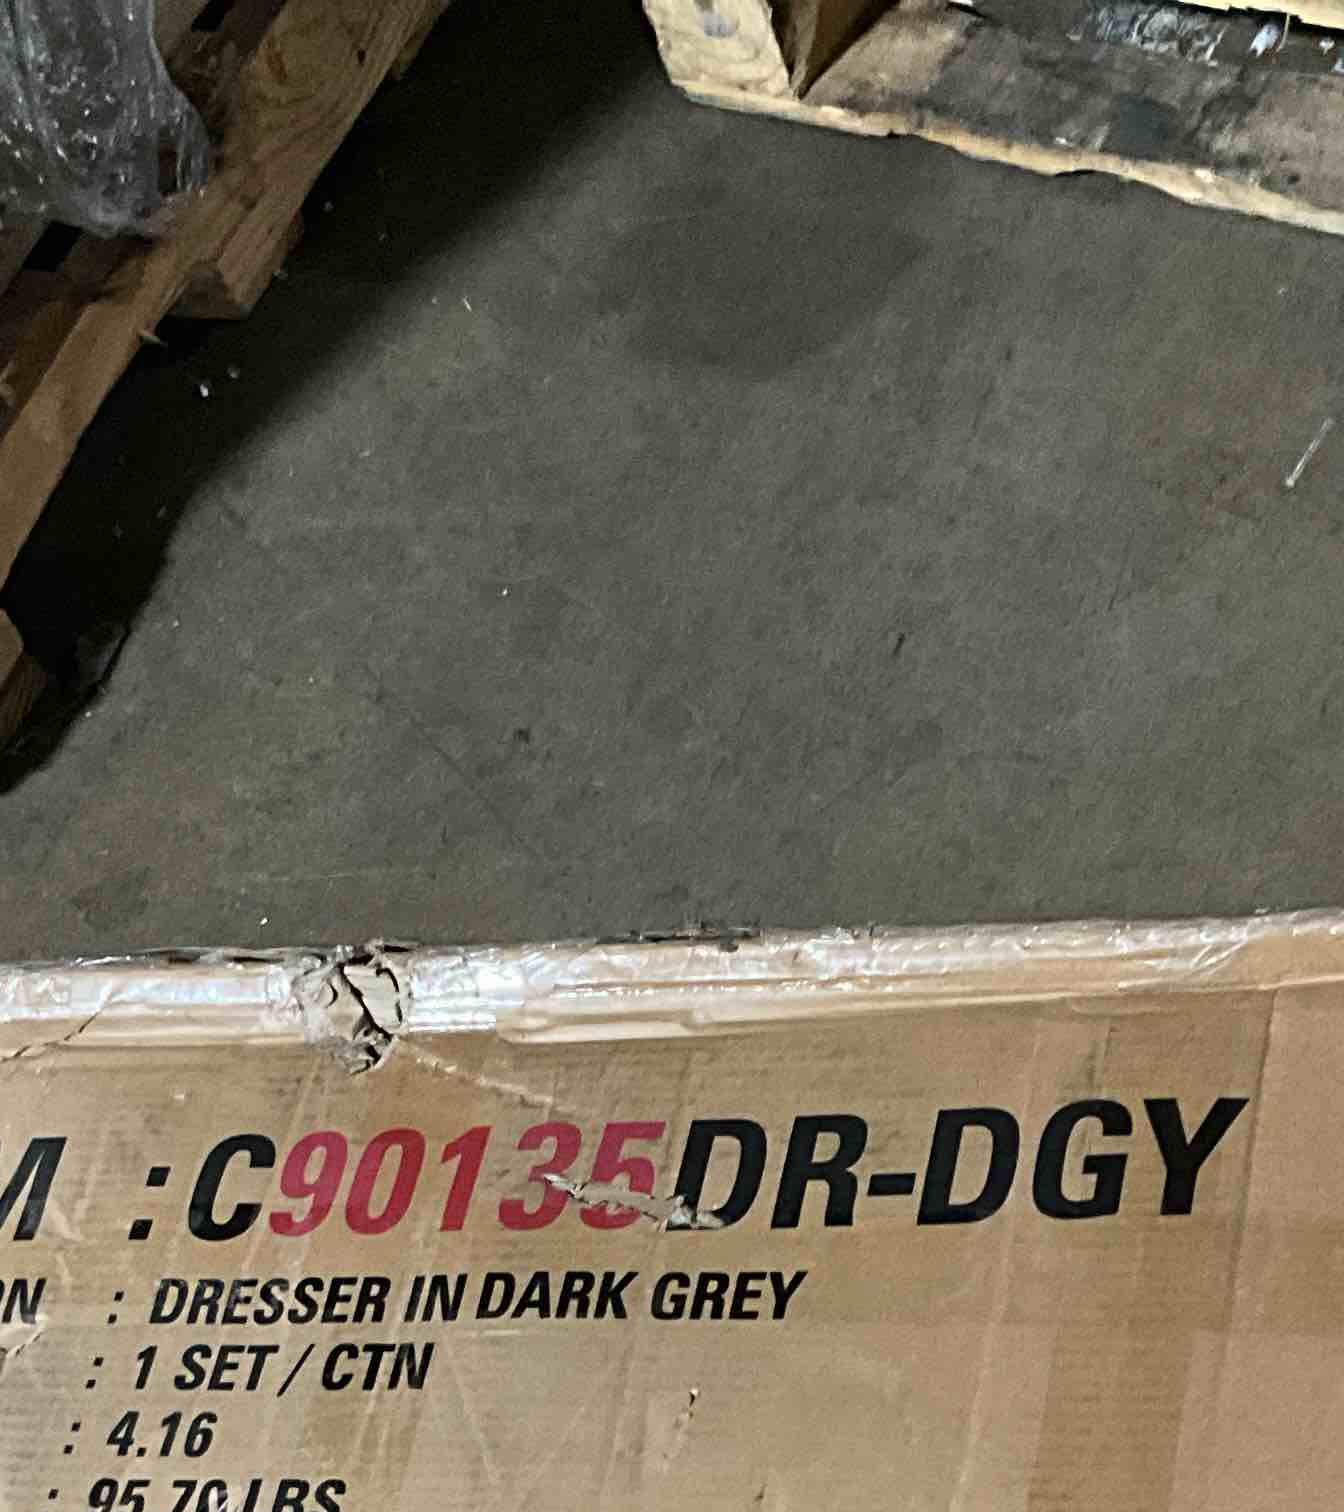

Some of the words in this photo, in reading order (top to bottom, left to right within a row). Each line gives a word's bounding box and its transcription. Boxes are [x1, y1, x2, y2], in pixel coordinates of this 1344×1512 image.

[148, 1275, 394, 1325] DRESSER
[403, 1273, 468, 1323] IN
[475, 1271, 638, 1321] DARK
[651, 1269, 807, 1321] GREY
[134, 1345, 158, 1391] 1
[173, 1343, 281, 1392] SET
[320, 1341, 435, 1392] CTN
[106, 1410, 219, 1459] 4.16
